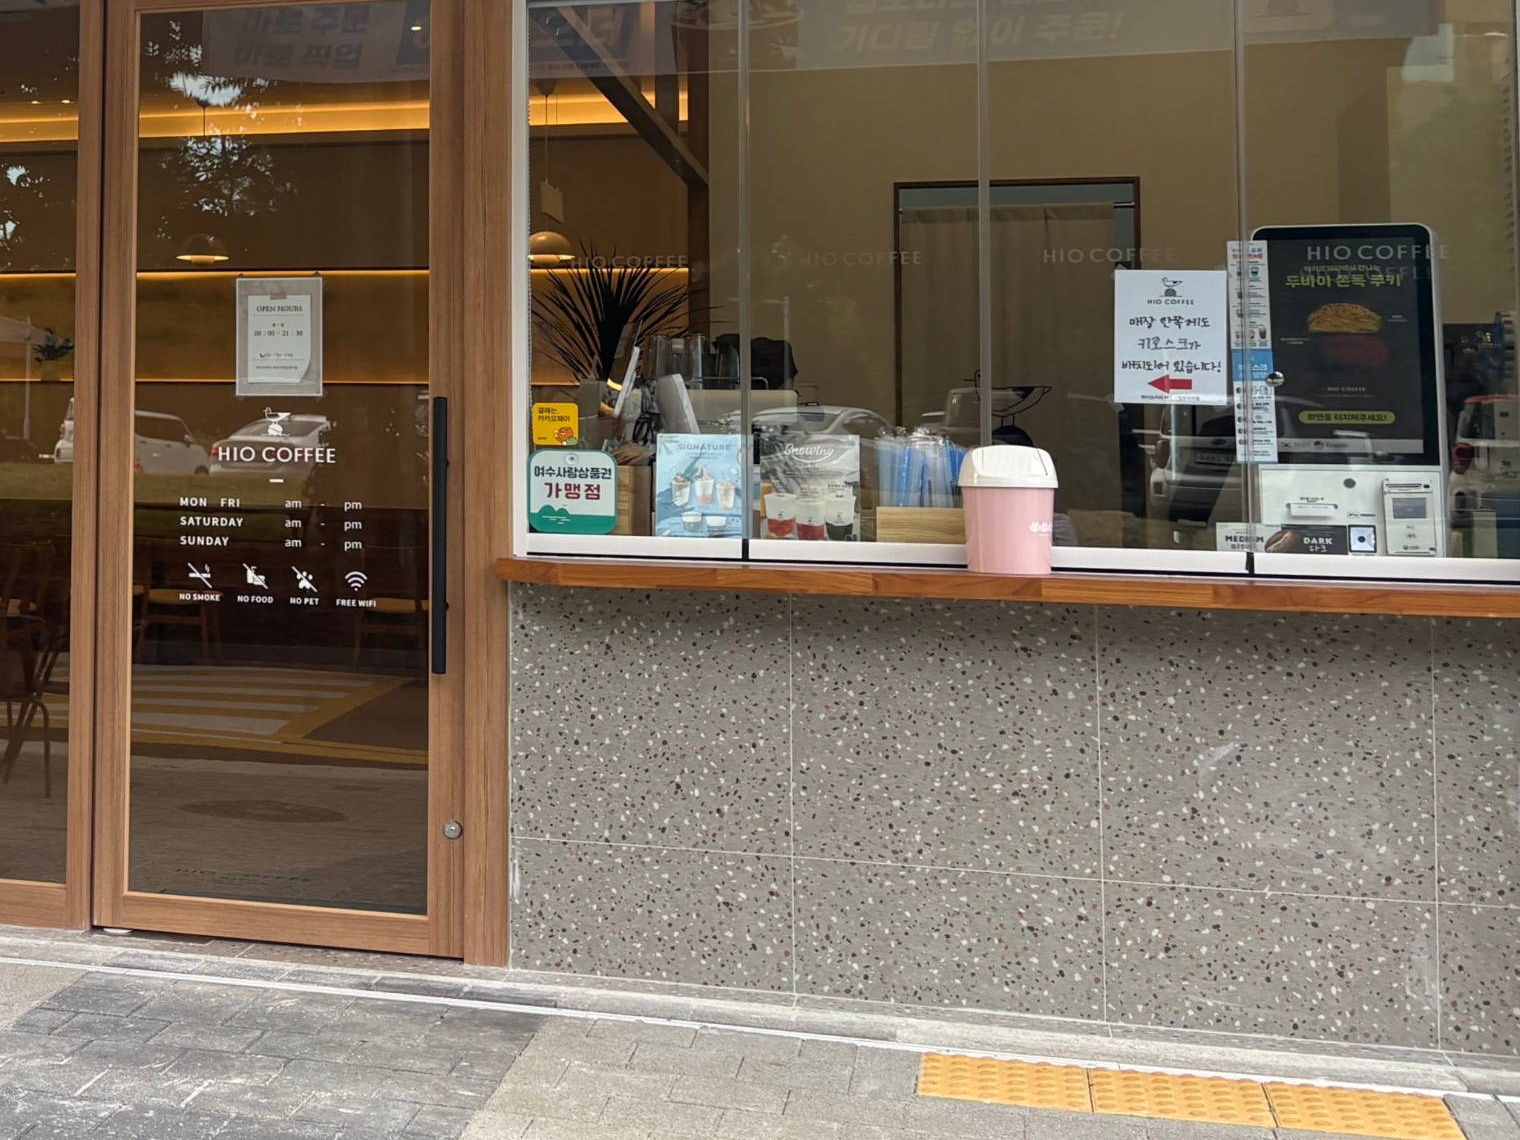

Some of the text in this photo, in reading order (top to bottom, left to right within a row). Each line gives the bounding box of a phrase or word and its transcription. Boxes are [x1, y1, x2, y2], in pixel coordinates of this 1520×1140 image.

[1043, 248, 1084, 263] HIO
[1307, 244, 1451, 260] HIO COFFEE
[1285, 274, 1331, 288] 두바이
[1369, 273, 1401, 287] 쿠키
[256, 305, 276, 313] OPEN
[1129, 316, 1157, 329] 매장
[1121, 360, 1222, 374] 배치되어 있습니다!
[217, 445, 337, 463] HIO COFFEE
[784, 442, 835, 456] Snowing
[533, 465, 612, 480] 여수사랑상품권
[544, 482, 601, 501] 가맹점
[179, 497, 207, 507] MON
[220, 498, 241, 508] FRI
[284, 499, 302, 508] am
[344, 500, 362, 512] pm
[180, 516, 244, 527] SATURDAY
[284, 519, 302, 528] am
[344, 520, 362, 532] pm
[180, 536, 230, 546] SUNDAY
[284, 538, 302, 547] am
[344, 540, 362, 552] pm
[1303, 537, 1333, 545] DARK
[179, 593, 221, 602] NO SMOKE
[237, 595, 274, 604] NO FOOD
[290, 597, 319, 606] NO PET
[336, 599, 377, 608] FREE WIFI
